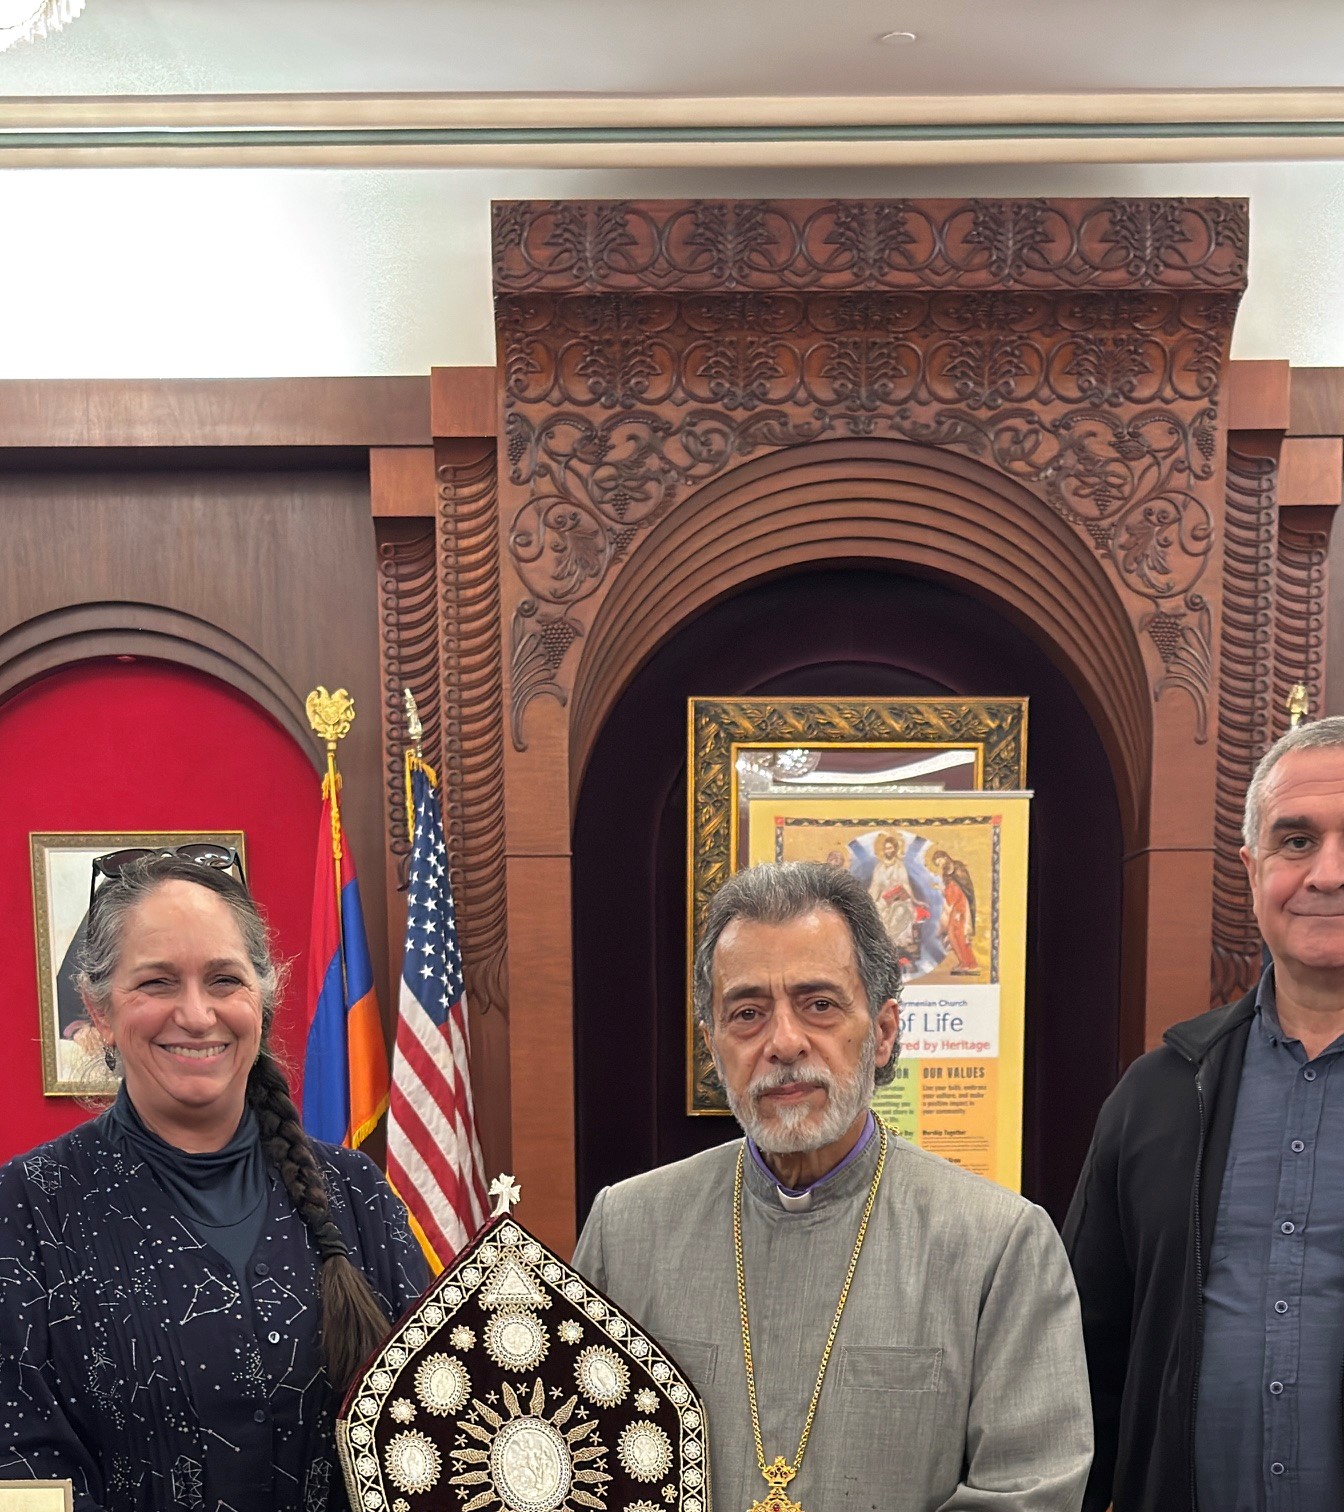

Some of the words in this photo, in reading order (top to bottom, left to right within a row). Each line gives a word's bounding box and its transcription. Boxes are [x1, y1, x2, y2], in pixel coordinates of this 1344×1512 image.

[938, 999, 968, 1007] Church
[924, 1012, 964, 1032] Life
[924, 1040, 938, 1053] by
[941, 1039, 991, 1053] Heritage
[923, 1068, 943, 1079] OUR
[947, 1066, 986, 1079] VALUES
